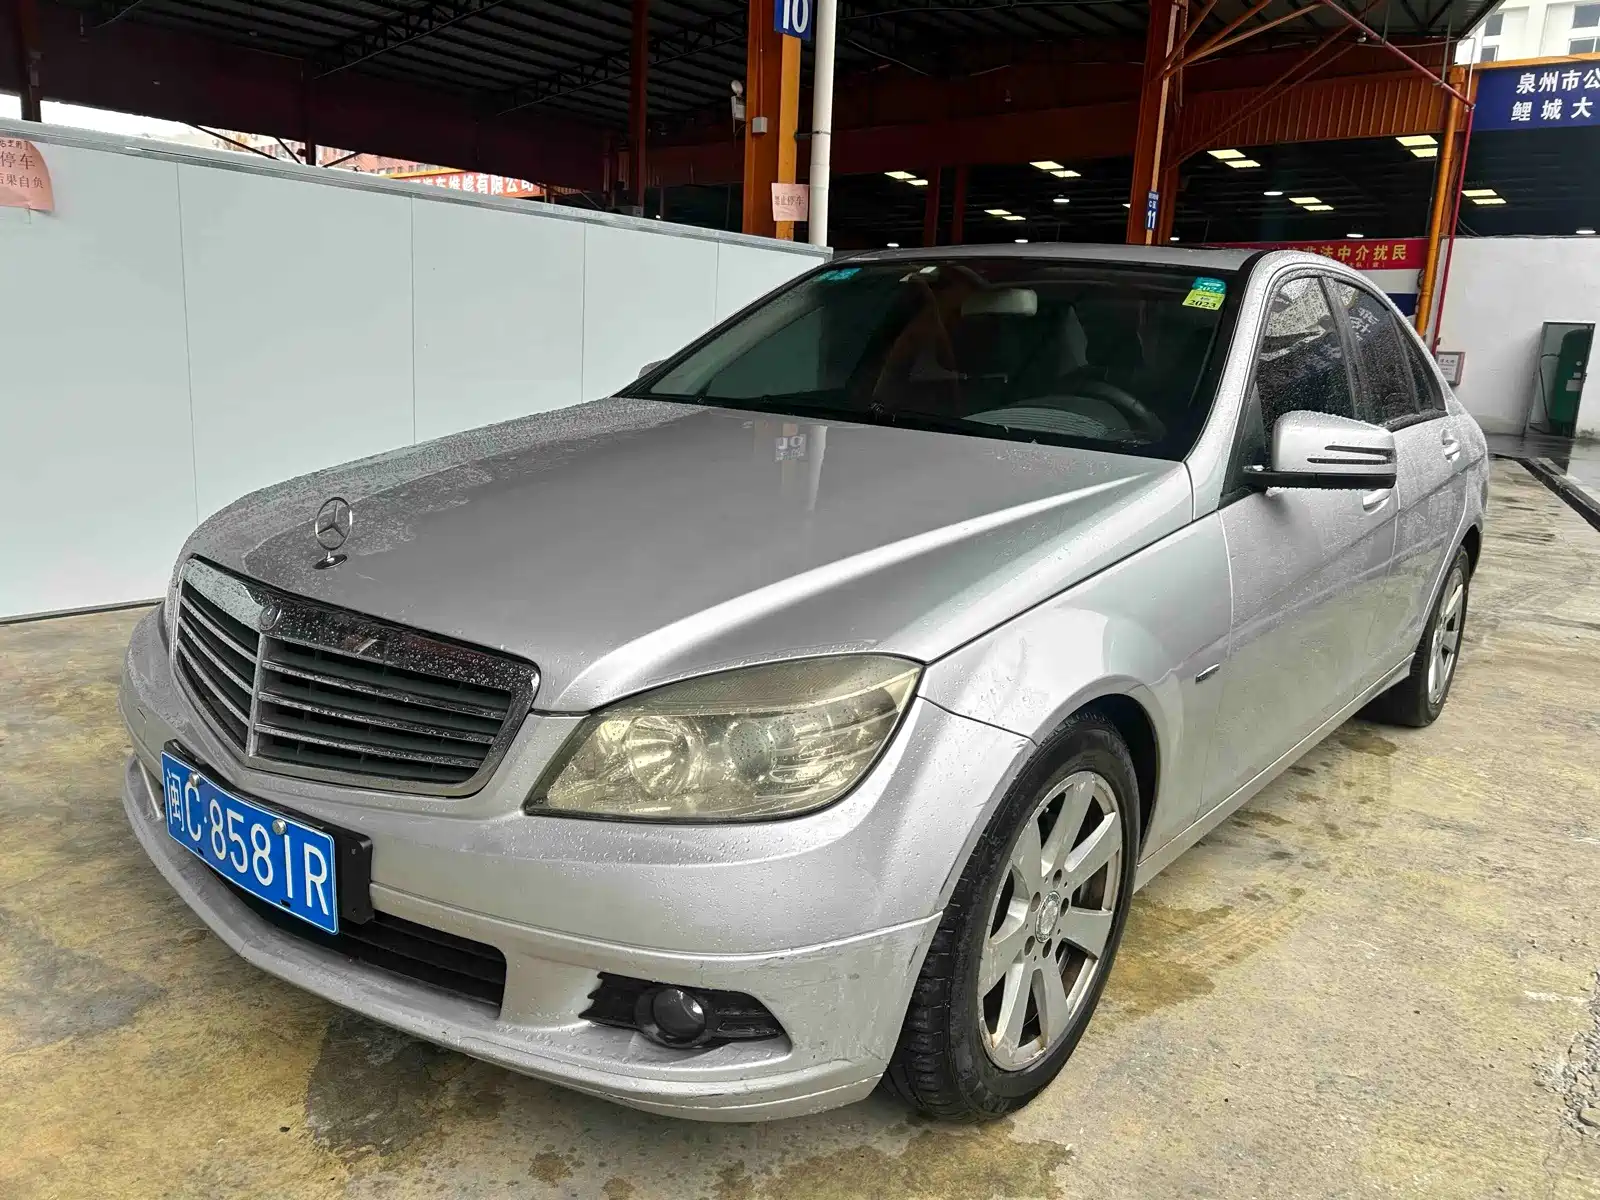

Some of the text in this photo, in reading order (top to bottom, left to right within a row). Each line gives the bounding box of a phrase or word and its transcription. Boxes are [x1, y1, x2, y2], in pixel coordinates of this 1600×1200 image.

[782, 0, 809, 33] 10
[1516, 67, 1600, 95] 泉州市公
[1510, 96, 1594, 122] 鲤城大
[0, 151, 36, 170] 停车
[1147, 210, 1156, 229] 11
[1188, 299, 1217, 309] 2023
